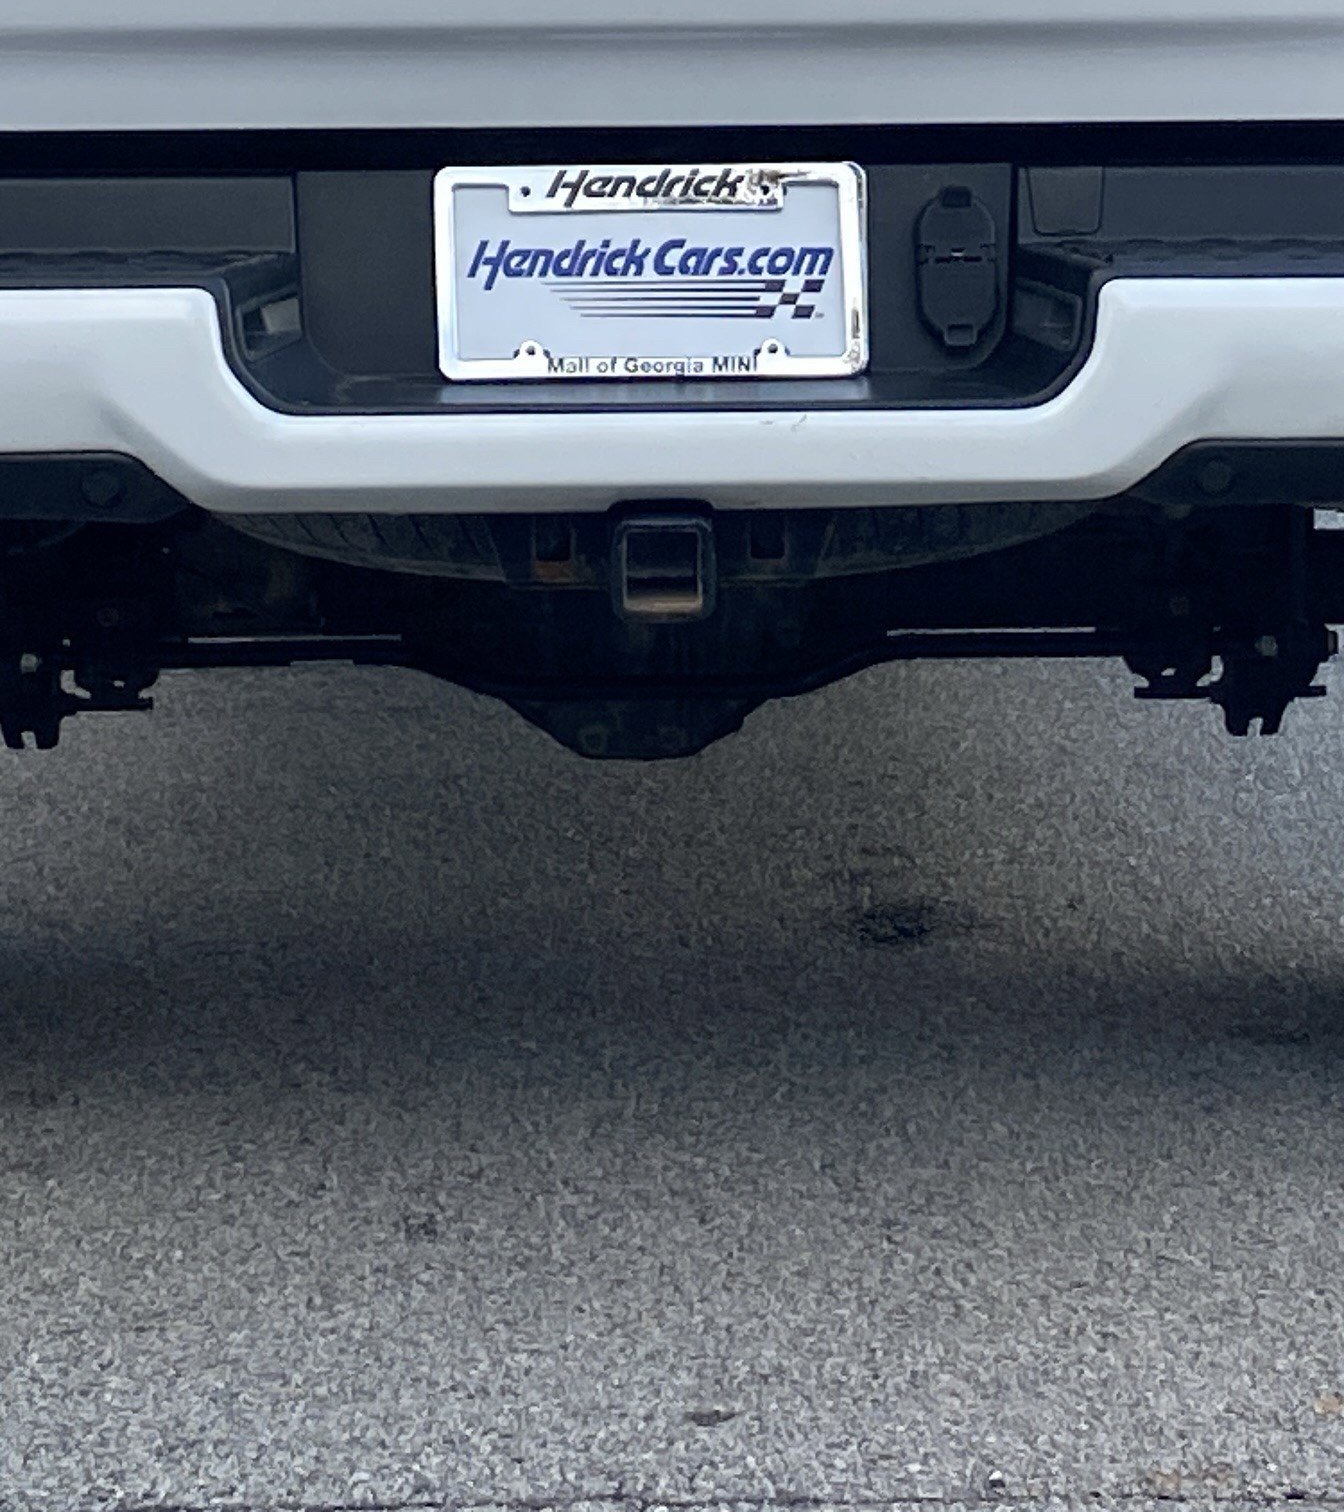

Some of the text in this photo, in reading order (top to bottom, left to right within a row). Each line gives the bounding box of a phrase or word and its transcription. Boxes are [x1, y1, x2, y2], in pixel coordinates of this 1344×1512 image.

[545, 168, 746, 208] Hendrick
[547, 356, 757, 376] Mall of Georgia MINI
